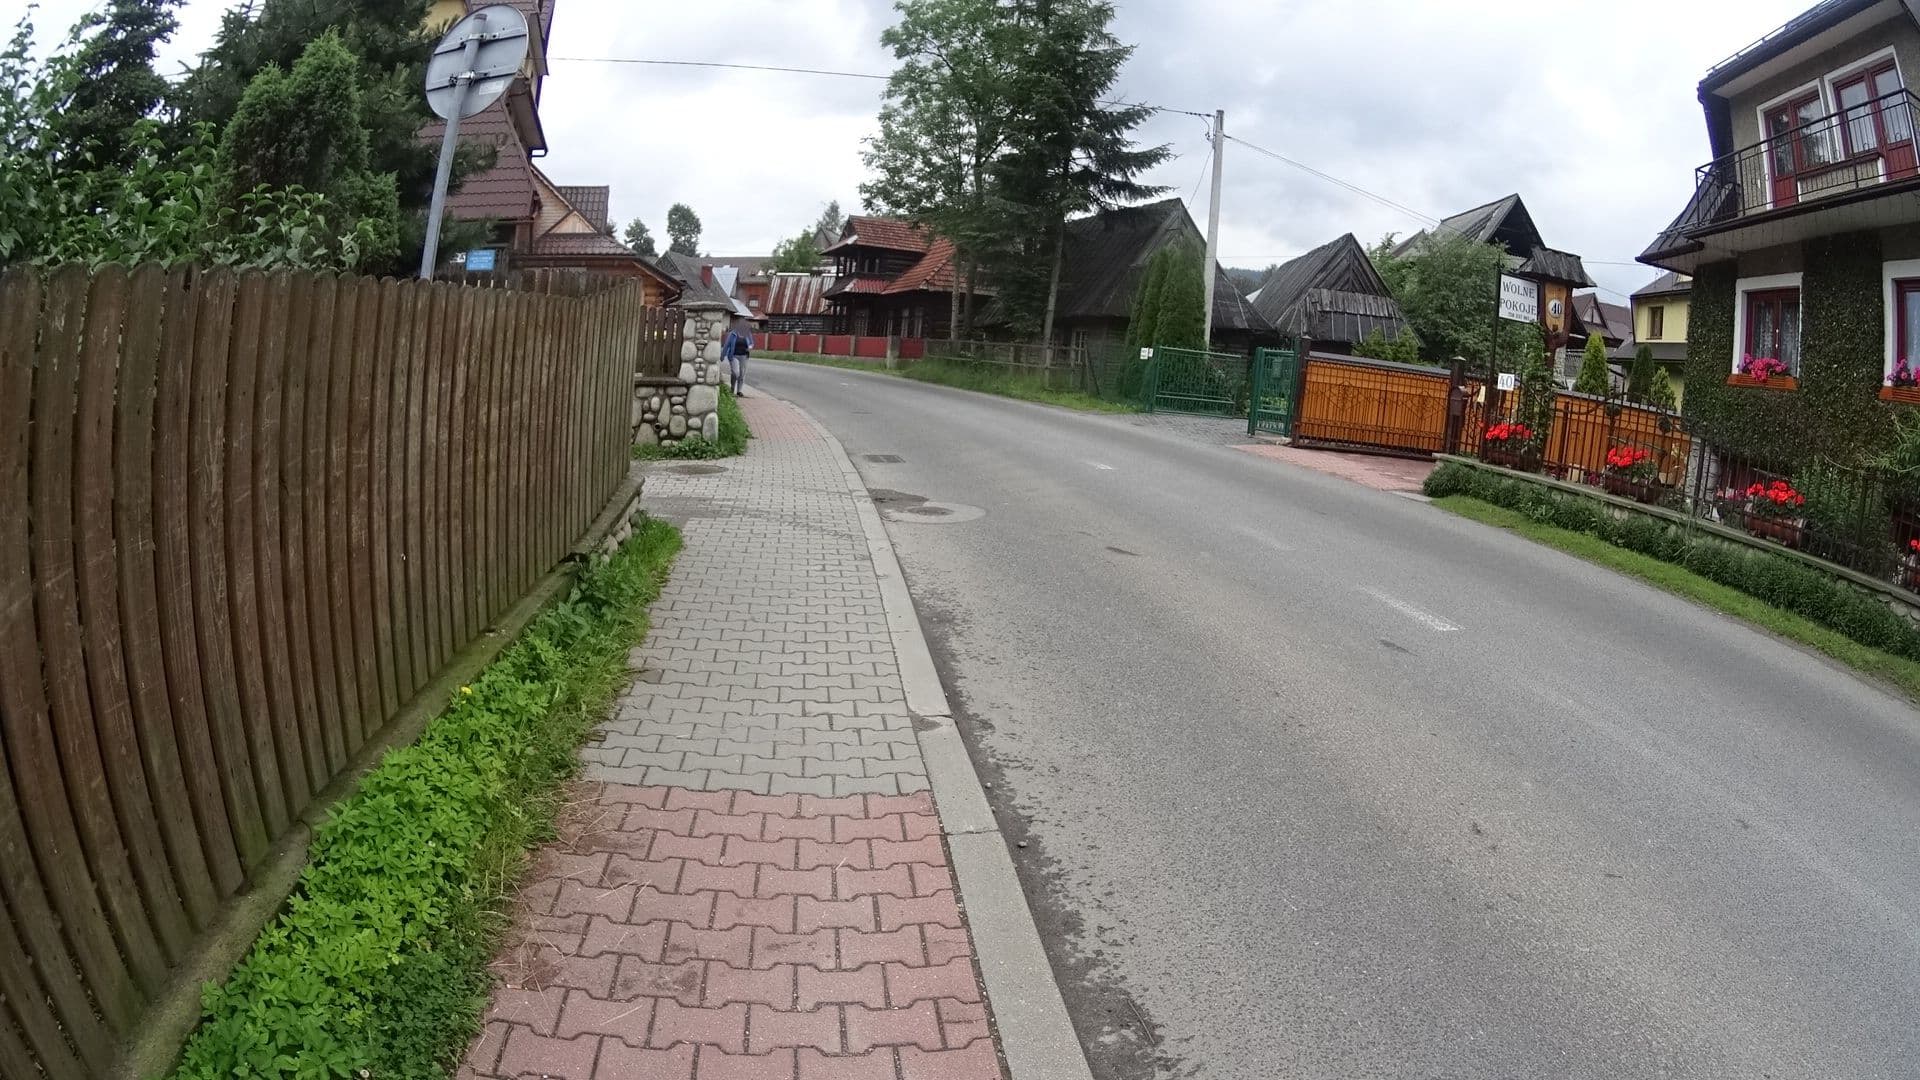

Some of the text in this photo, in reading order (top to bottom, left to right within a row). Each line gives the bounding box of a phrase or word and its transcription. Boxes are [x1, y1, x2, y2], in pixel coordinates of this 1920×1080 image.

[1503, 281, 1535, 299] WOLNE
[1500, 298, 1536, 315] POKOJE
[1551, 302, 1562, 314] 40
[1499, 375, 1513, 388] 40
